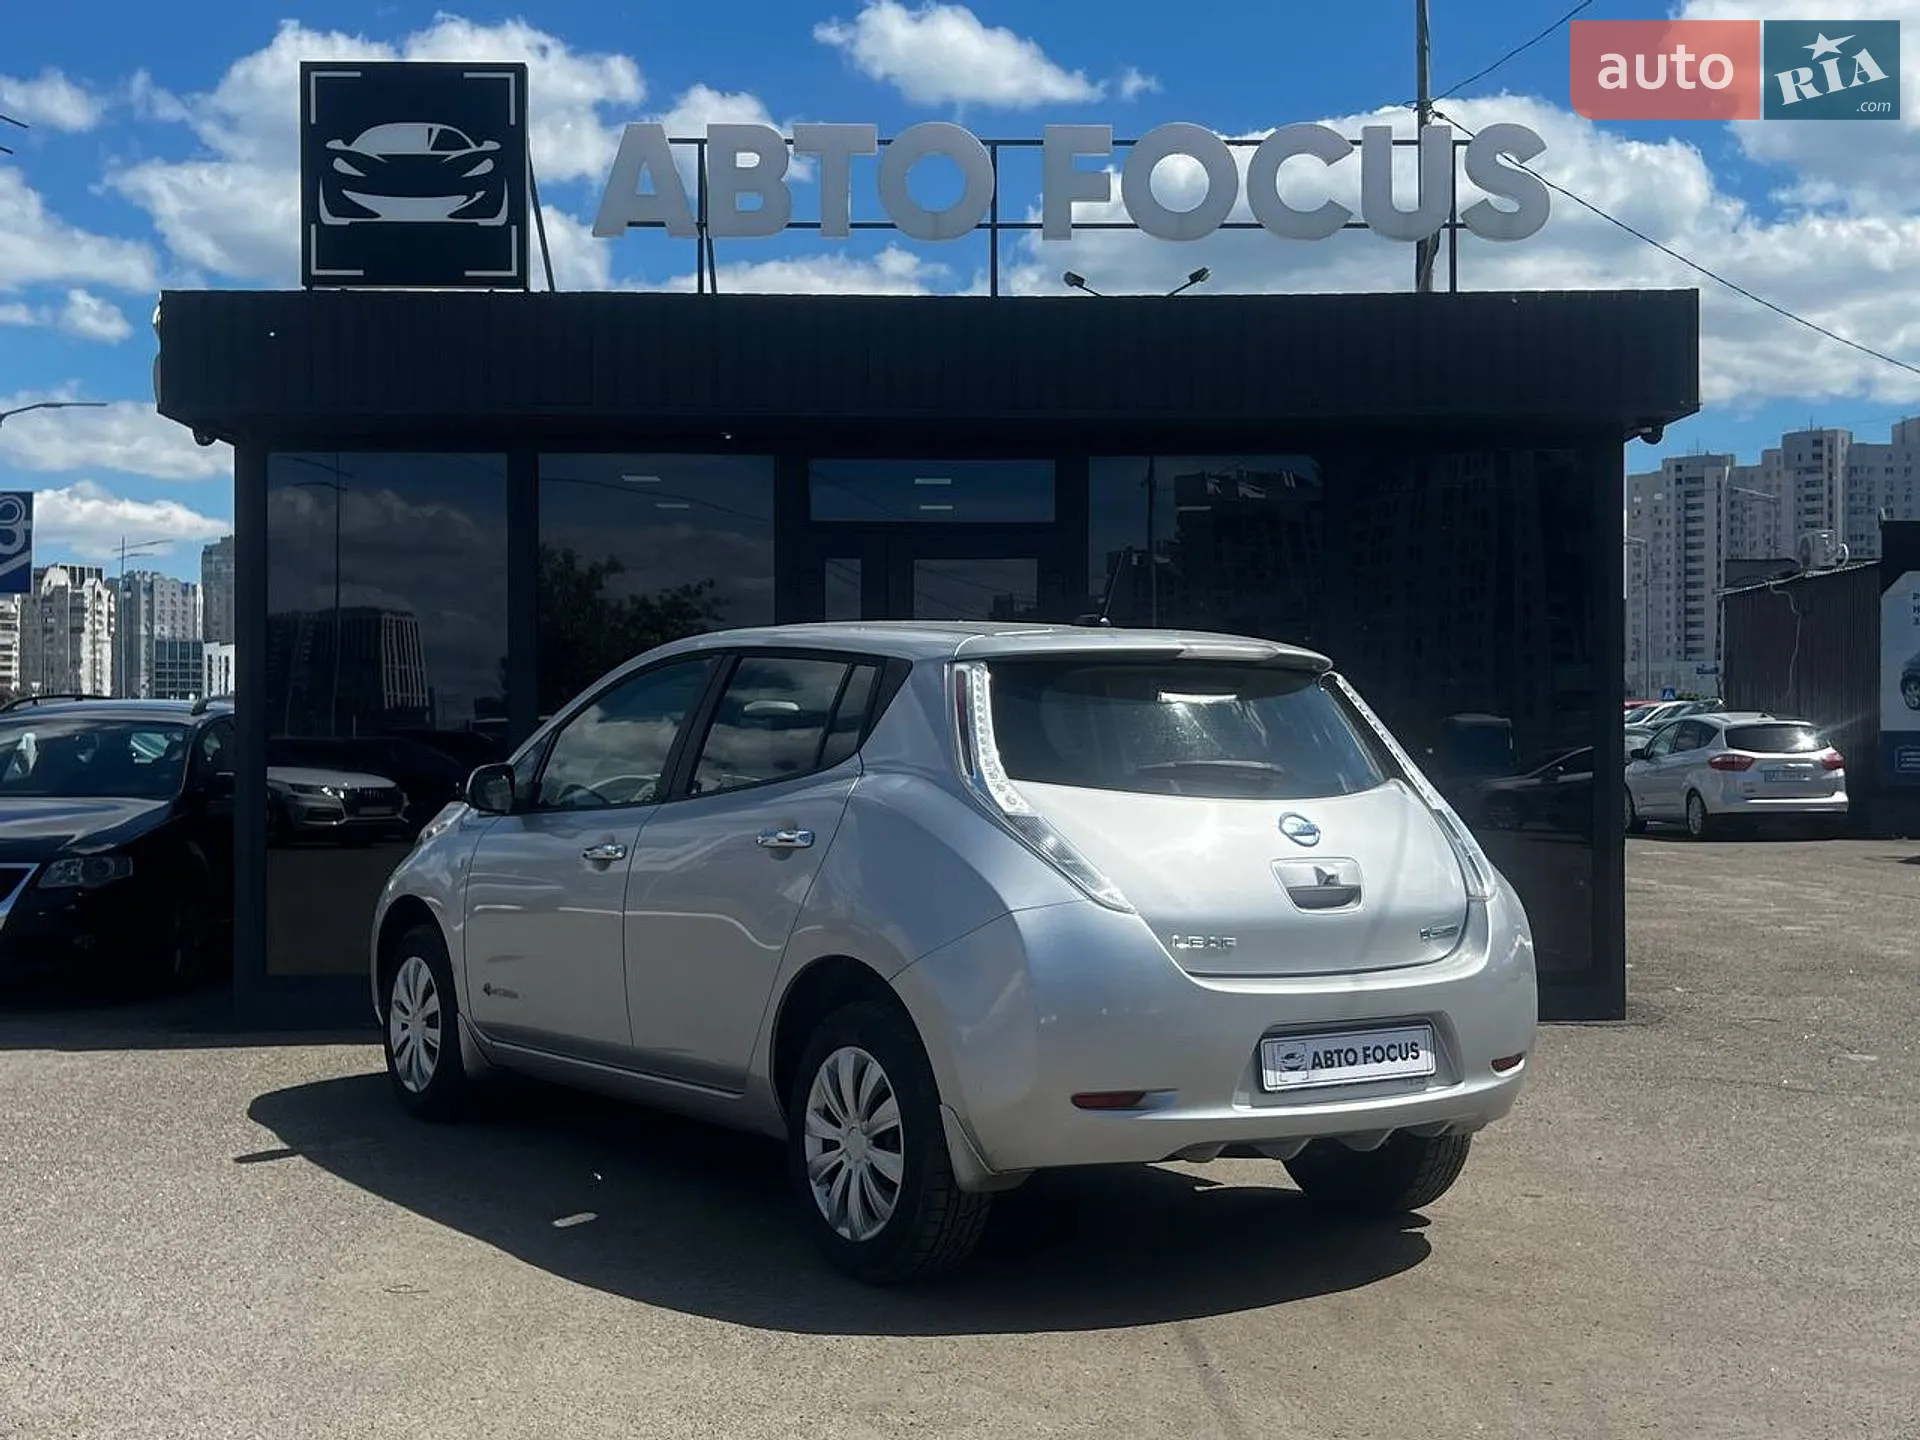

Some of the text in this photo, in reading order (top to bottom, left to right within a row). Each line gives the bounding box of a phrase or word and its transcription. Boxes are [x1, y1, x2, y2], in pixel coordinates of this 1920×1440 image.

[592, 121, 1551, 242] АВТО FOCUS
[1311, 1041, 1420, 1070] АВТО FOCUS
